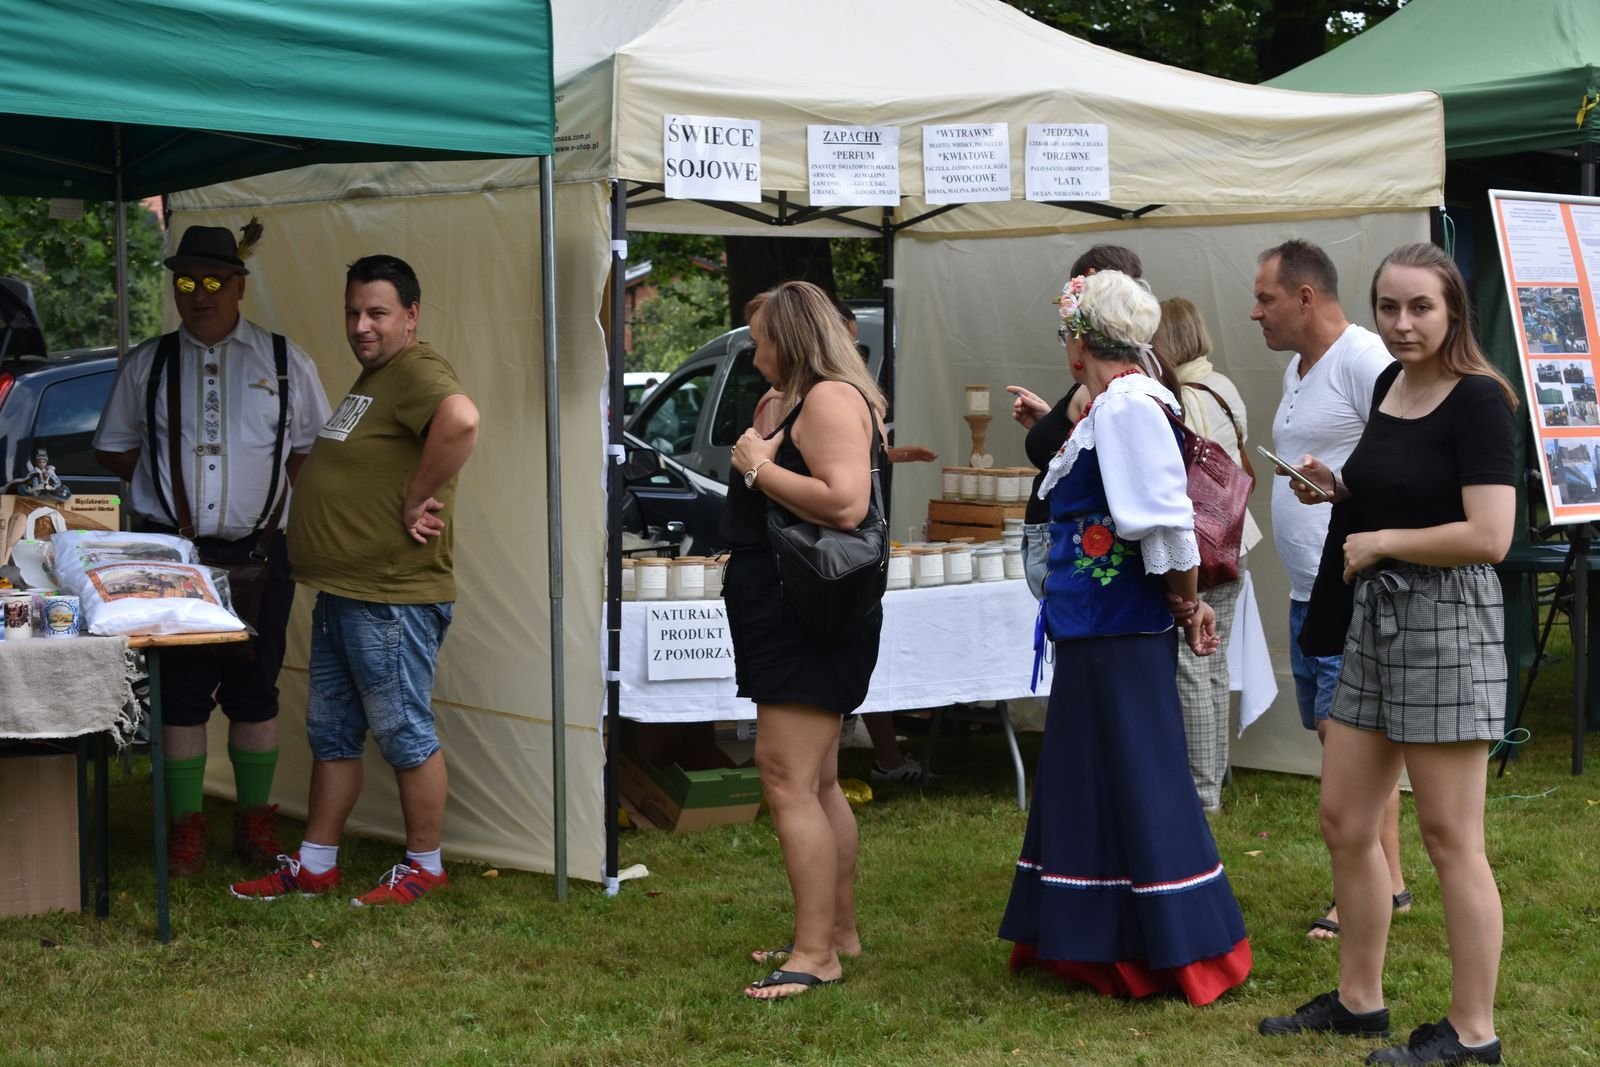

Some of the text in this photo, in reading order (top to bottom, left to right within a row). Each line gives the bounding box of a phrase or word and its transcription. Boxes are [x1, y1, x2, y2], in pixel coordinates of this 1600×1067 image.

[668, 117, 754, 147] ŚWIECE
[823, 130, 883, 143] ZAPACHY
[666, 157, 758, 181] SOJOWE
[651, 608, 726, 621] NATURALN
[661, 627, 725, 641] PRODUKT
[653, 647, 732, 661] Z POMORZA
